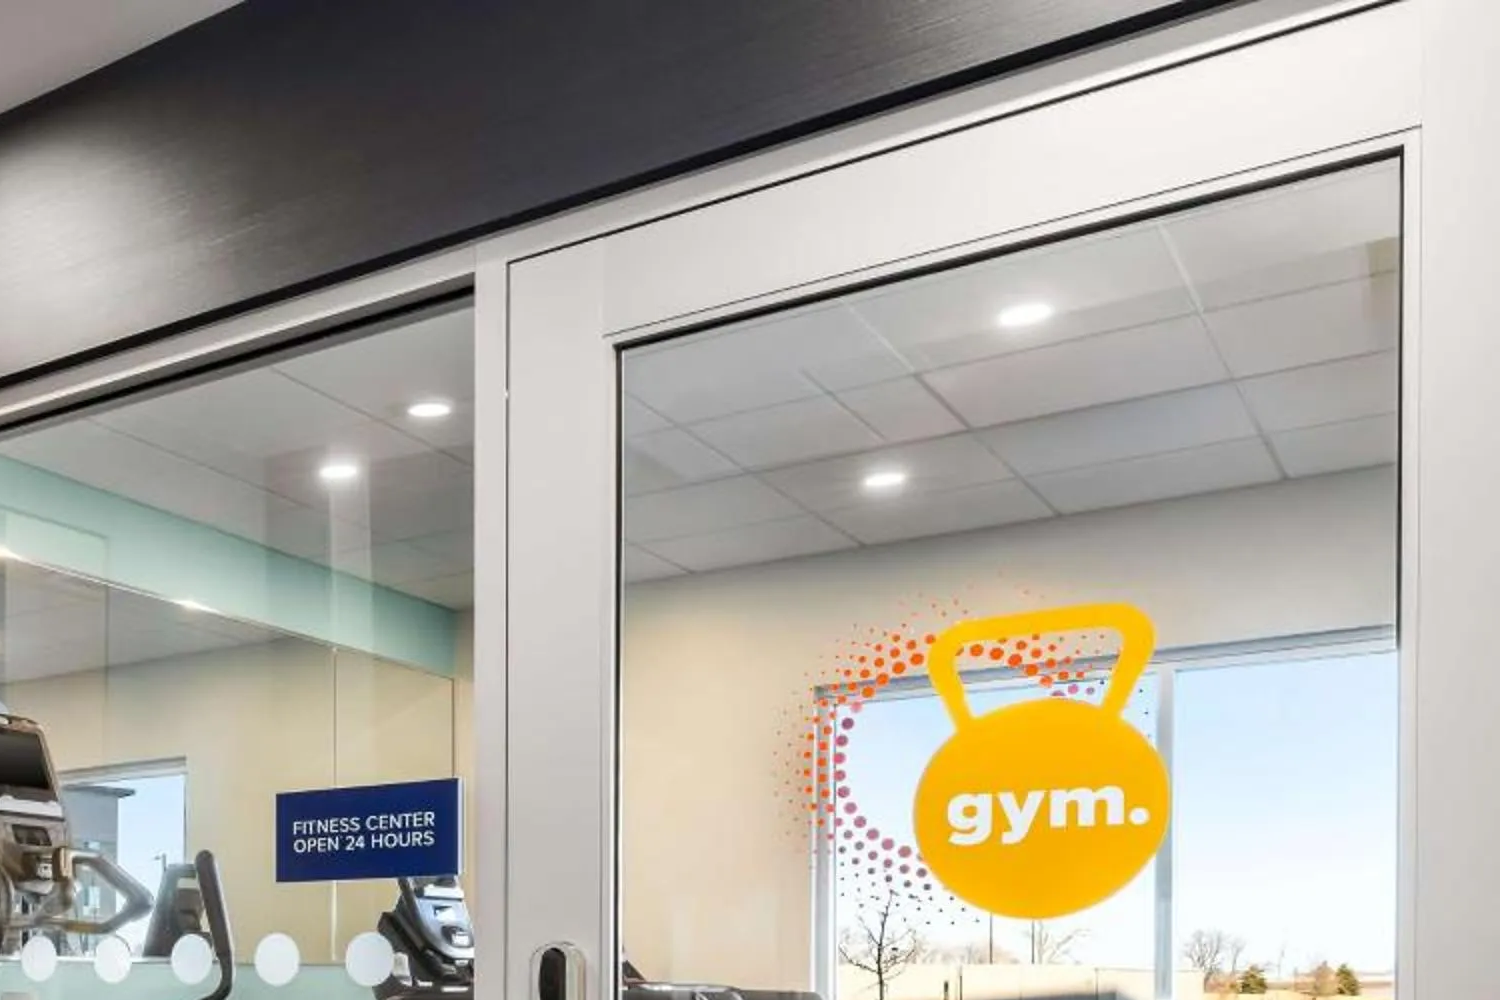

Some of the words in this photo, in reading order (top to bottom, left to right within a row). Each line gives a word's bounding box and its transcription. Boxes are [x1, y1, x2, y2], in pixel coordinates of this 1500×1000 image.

[293, 817, 360, 835] FITNESS
[365, 811, 435, 831] CENTER
[946, 785, 1150, 846] gym.
[293, 837, 339, 854] OPEN
[346, 835, 365, 850] 24
[371, 831, 435, 849] HOURS
